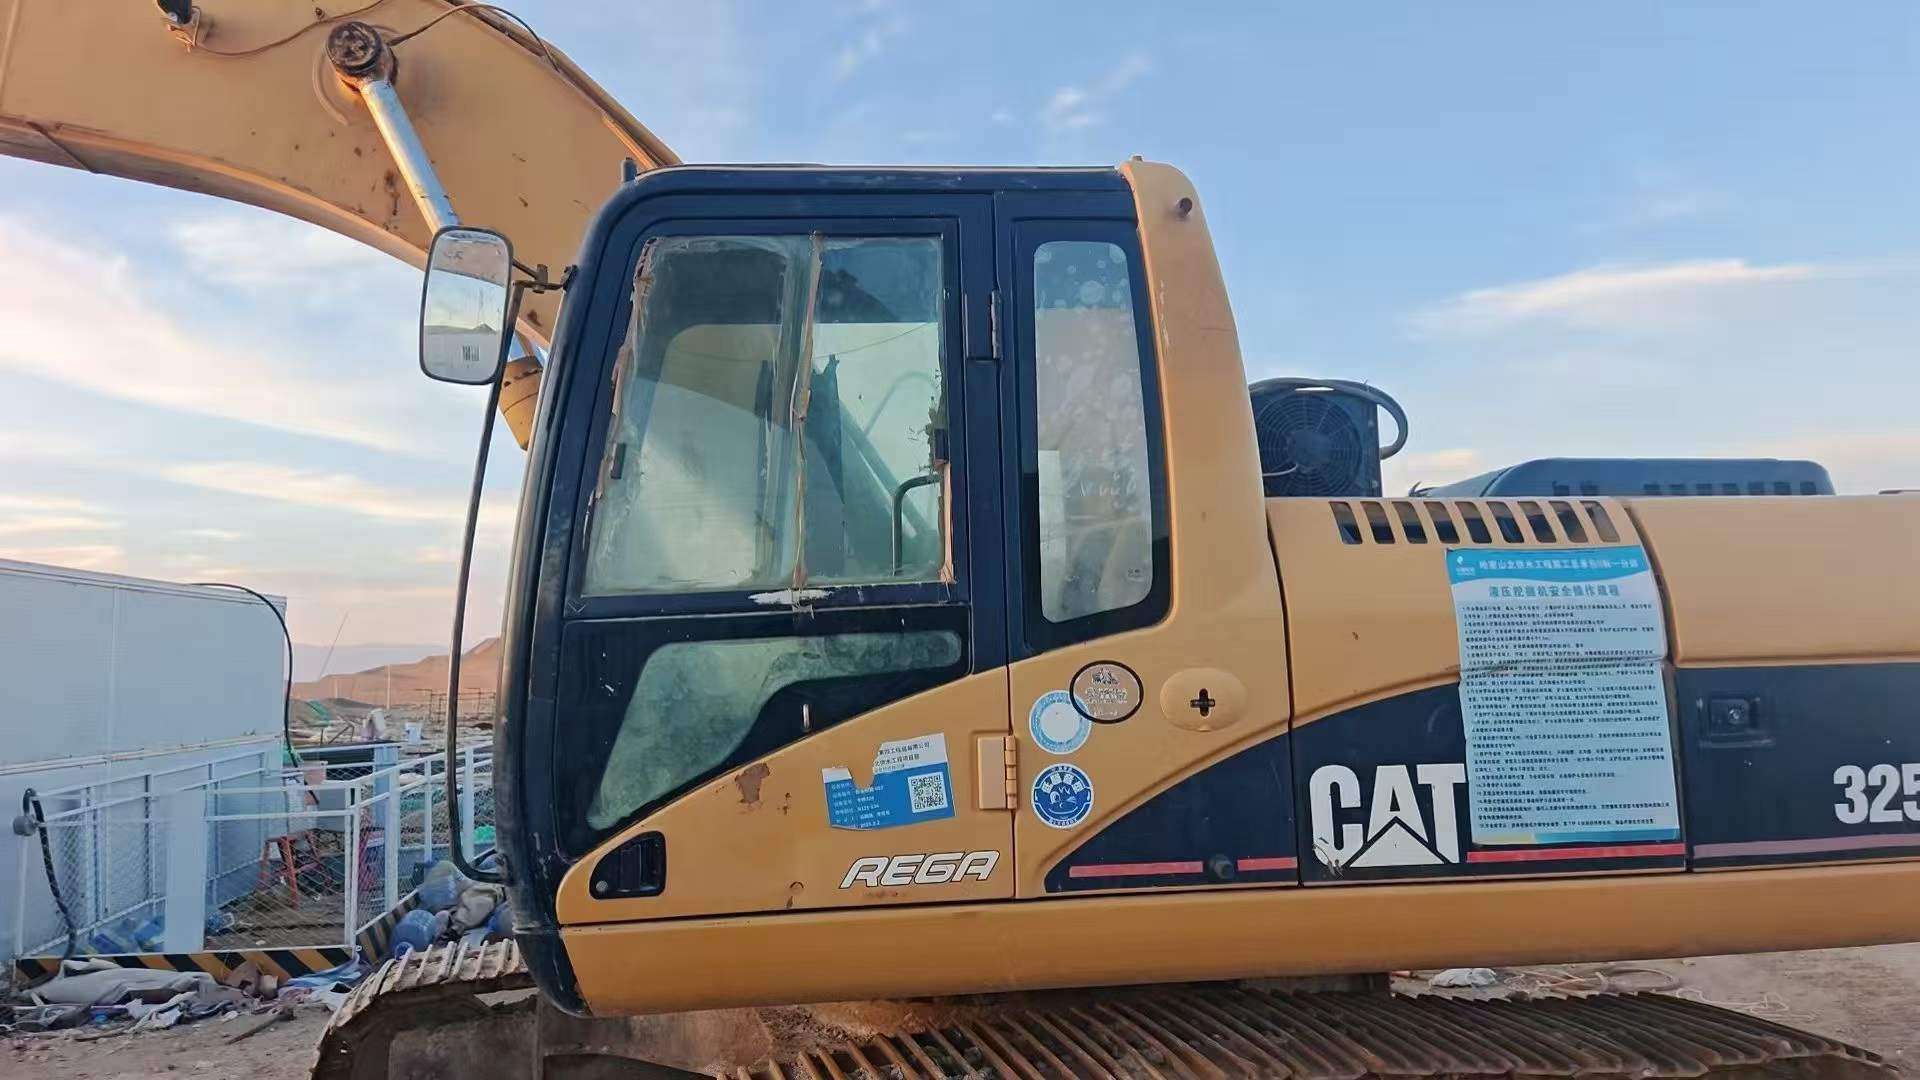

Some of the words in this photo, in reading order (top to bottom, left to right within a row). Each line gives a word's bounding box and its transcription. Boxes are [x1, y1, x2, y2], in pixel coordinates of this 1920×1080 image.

[1489, 585, 1621, 598] 液压挖掘机安全操作规程
[1309, 763, 1467, 869] CAT
[1833, 763, 1920, 824] 325
[839, 850, 1000, 889] REGA
